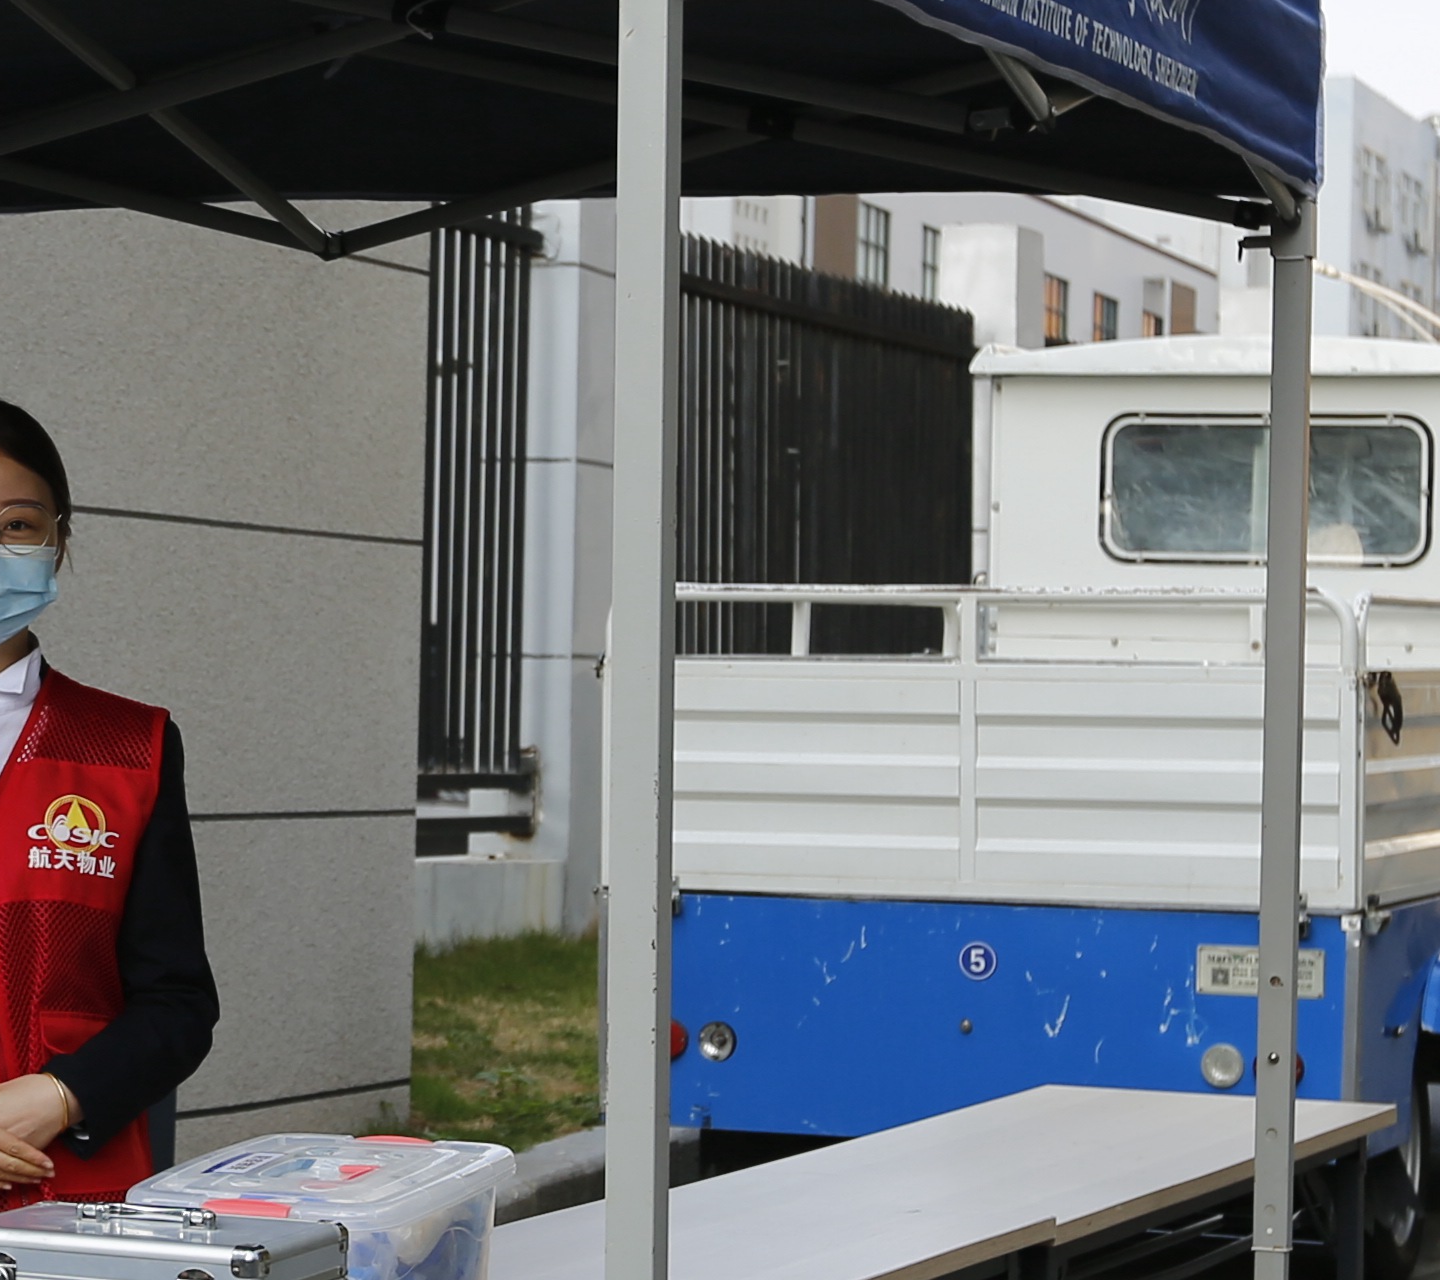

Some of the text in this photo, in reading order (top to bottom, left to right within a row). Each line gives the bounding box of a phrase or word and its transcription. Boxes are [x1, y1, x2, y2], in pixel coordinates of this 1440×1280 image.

[1074, 13, 1089, 48] OF
[1091, 21, 1153, 81] TECHNOLOGY,
[1155, 52, 1199, 100] SHENZHEN
[28, 846, 117, 878] 航天物业
[970, 948, 986, 973] 5
